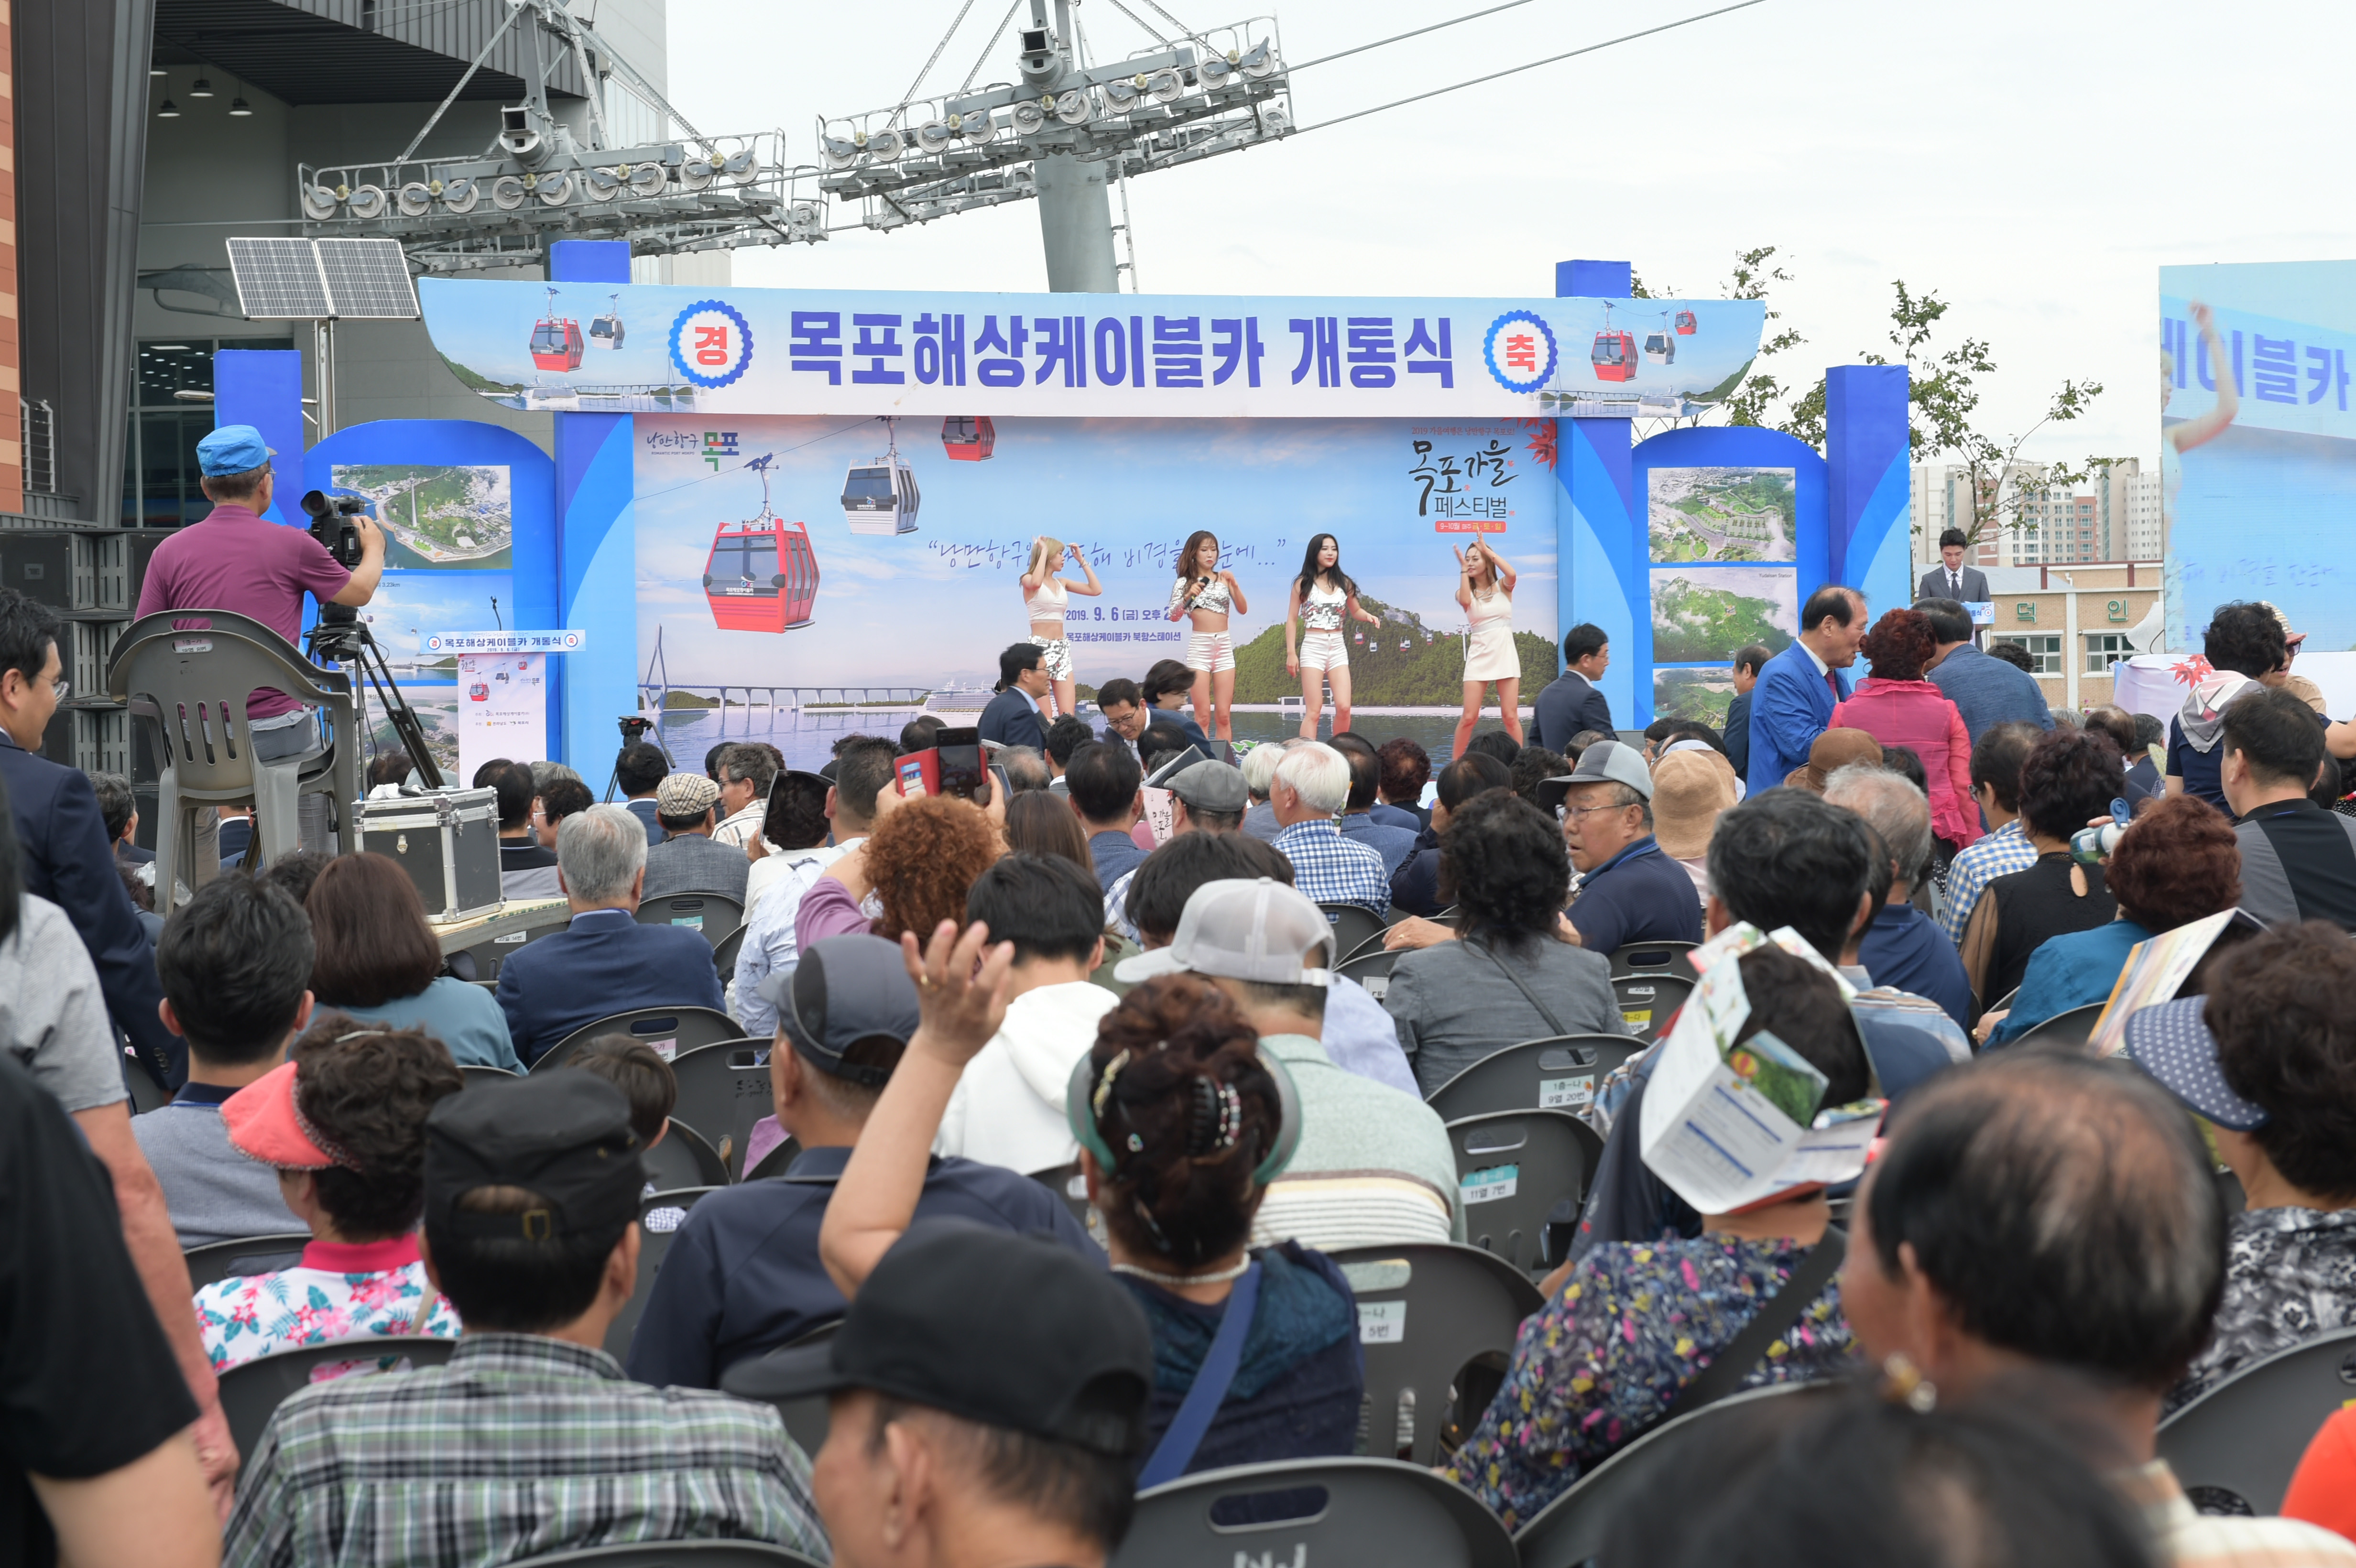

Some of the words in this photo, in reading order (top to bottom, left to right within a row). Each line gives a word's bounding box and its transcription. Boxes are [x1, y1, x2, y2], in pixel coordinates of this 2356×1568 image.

[695, 326, 728, 366] 경
[789, 311, 1264, 388] 목포해상케이블카
[1289, 316, 1454, 388] 개통식
[1506, 333, 1536, 372] 축
[647, 431, 699, 449] 낭만항구
[701, 432, 739, 471] 목포
[1408, 440, 1462, 517] 목포
[1464, 439, 1519, 487] 가을
[1435, 496, 1506, 518] 페스티벌
[1440, 523, 1460, 531] 9~10월
[1066, 610, 1089, 621] 2019.
[1094, 607, 1105, 621] 9.
[1111, 607, 1119, 621] 6
[1123, 610, 1138, 621] (금)
[1142, 610, 1161, 620] 오후
[2017, 602, 2036, 623] 덕
[2107, 599, 2128, 622] 인
[445, 638, 527, 647] 목포해상케이블카
[532, 636, 561, 646] 개통식
[1067, 632, 1131, 642] 목포해상케이블카
[1133, 632, 1181, 642] 북항스테이션
[1554, 1079, 1581, 1090] 1층-나
[1549, 1094, 1562, 1103] 9열
[1567, 1091, 1585, 1101] 20번
[1471, 1187, 1487, 1198] 11열
[1492, 1184, 1506, 1195] 7번
